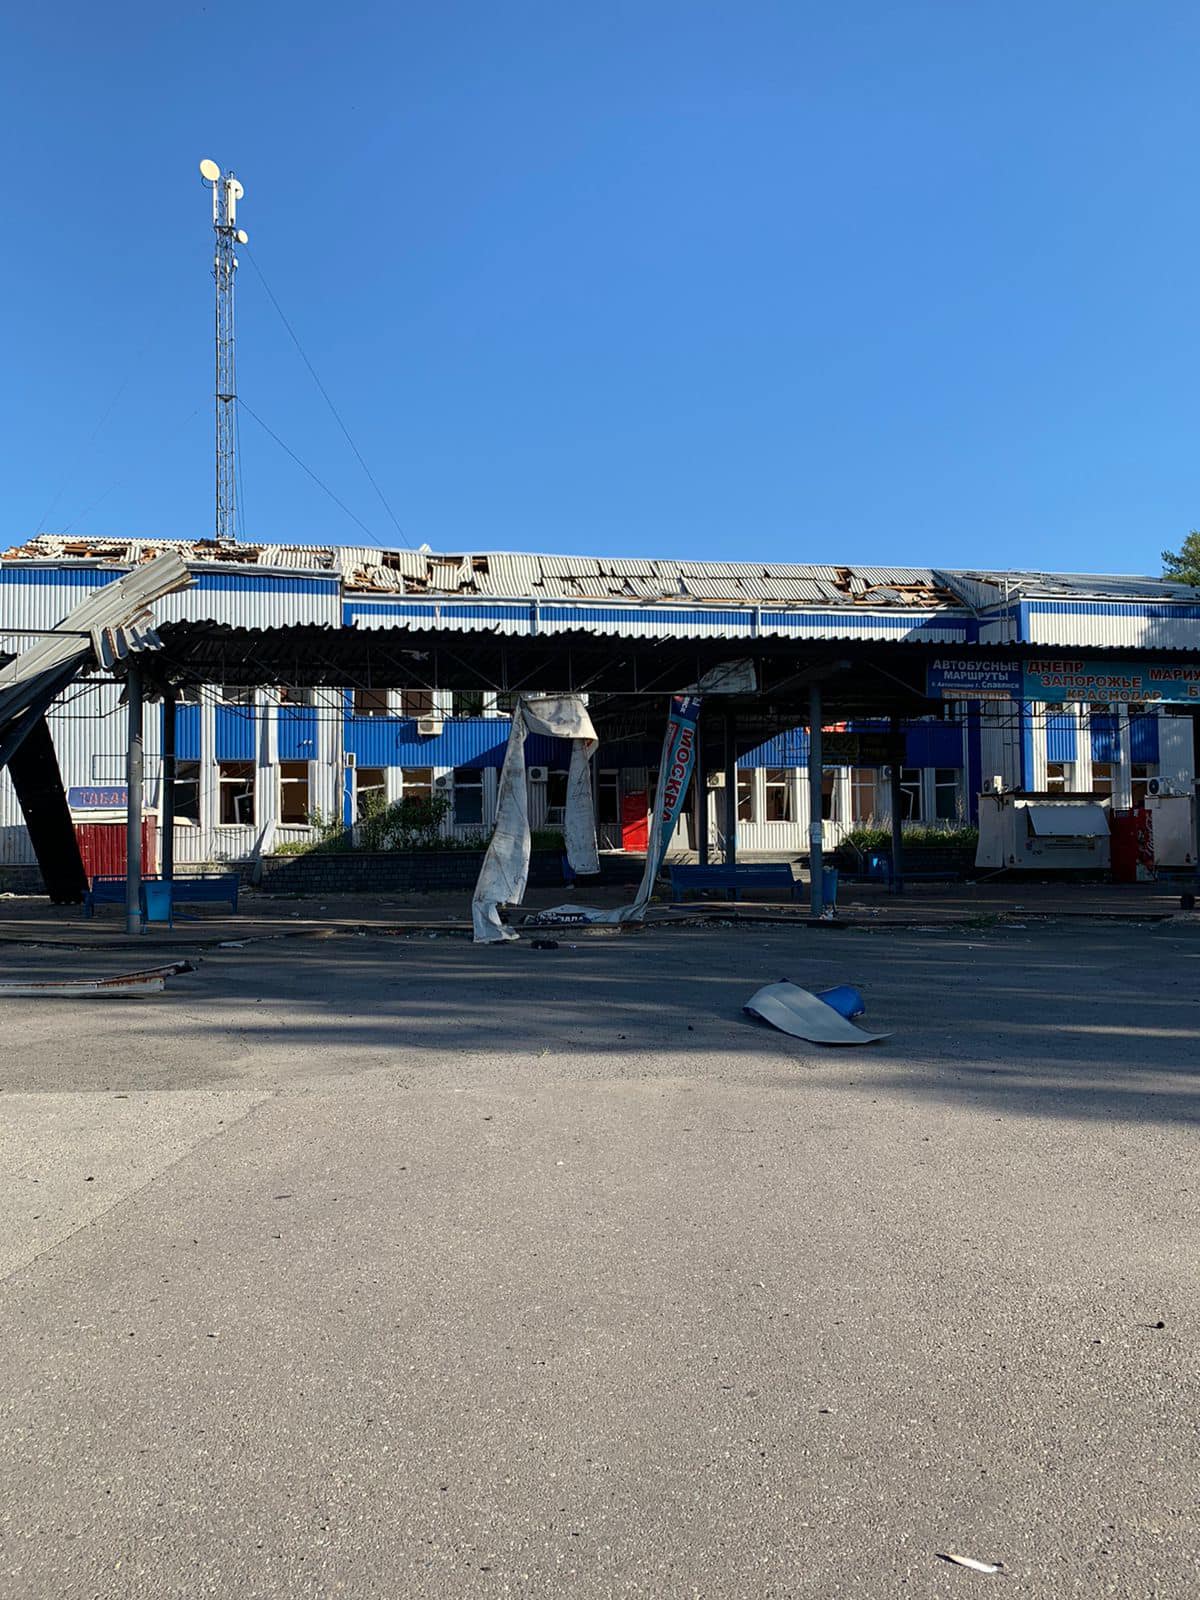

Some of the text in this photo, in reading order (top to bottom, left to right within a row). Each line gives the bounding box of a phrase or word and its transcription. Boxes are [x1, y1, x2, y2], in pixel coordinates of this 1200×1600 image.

[932, 658, 1020, 672] АВТОБУСНЫЕ
[1027, 661, 1085, 674] ДНЕПР
[943, 670, 1009, 681] МАРШРУТЫ
[1041, 674, 1143, 689] ЗАПОРОЖЬЕ
[1065, 687, 1163, 702] КРАСНОДАР
[662, 727, 695, 822] МОСКВА
